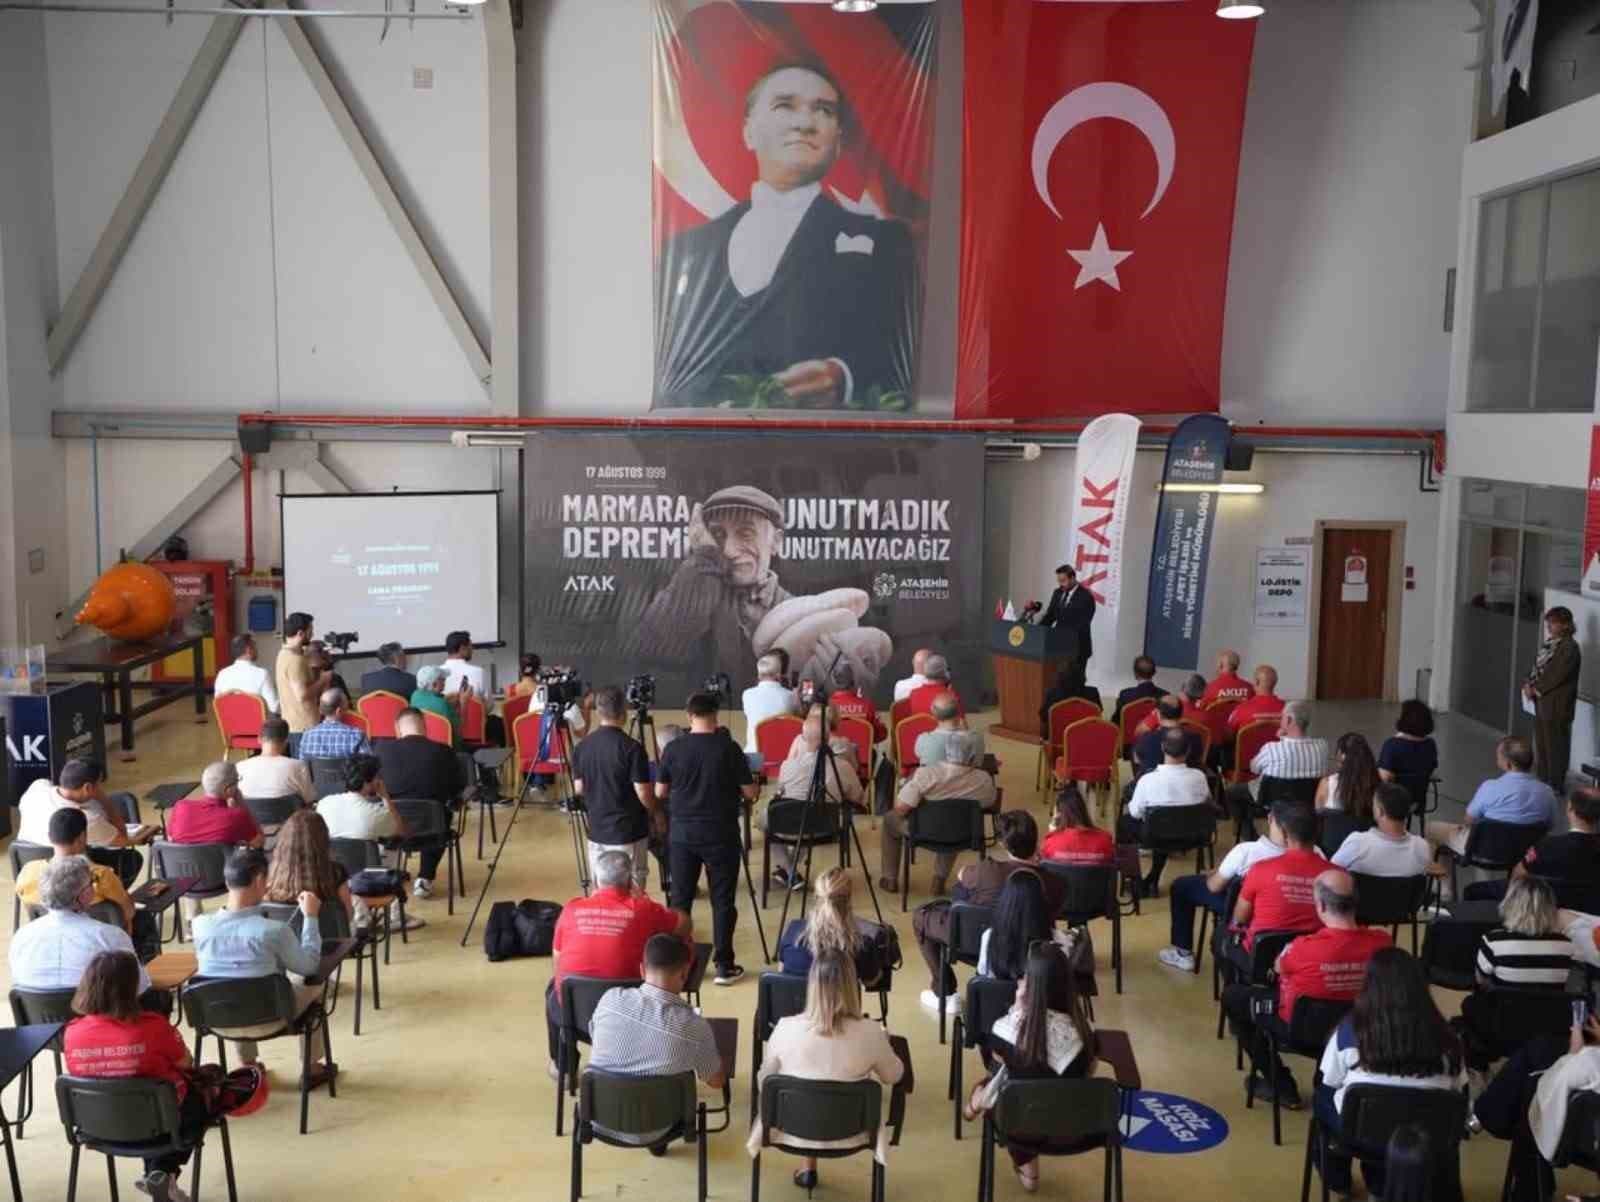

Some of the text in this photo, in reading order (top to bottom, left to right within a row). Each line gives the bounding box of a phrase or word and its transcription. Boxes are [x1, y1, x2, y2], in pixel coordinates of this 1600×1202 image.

[562, 494, 690, 522] MARMARA
[779, 534, 950, 560] UNUTMAYACAĞIZ
[563, 575, 616, 592] ATAK
[6, 734, 47, 761] AK
